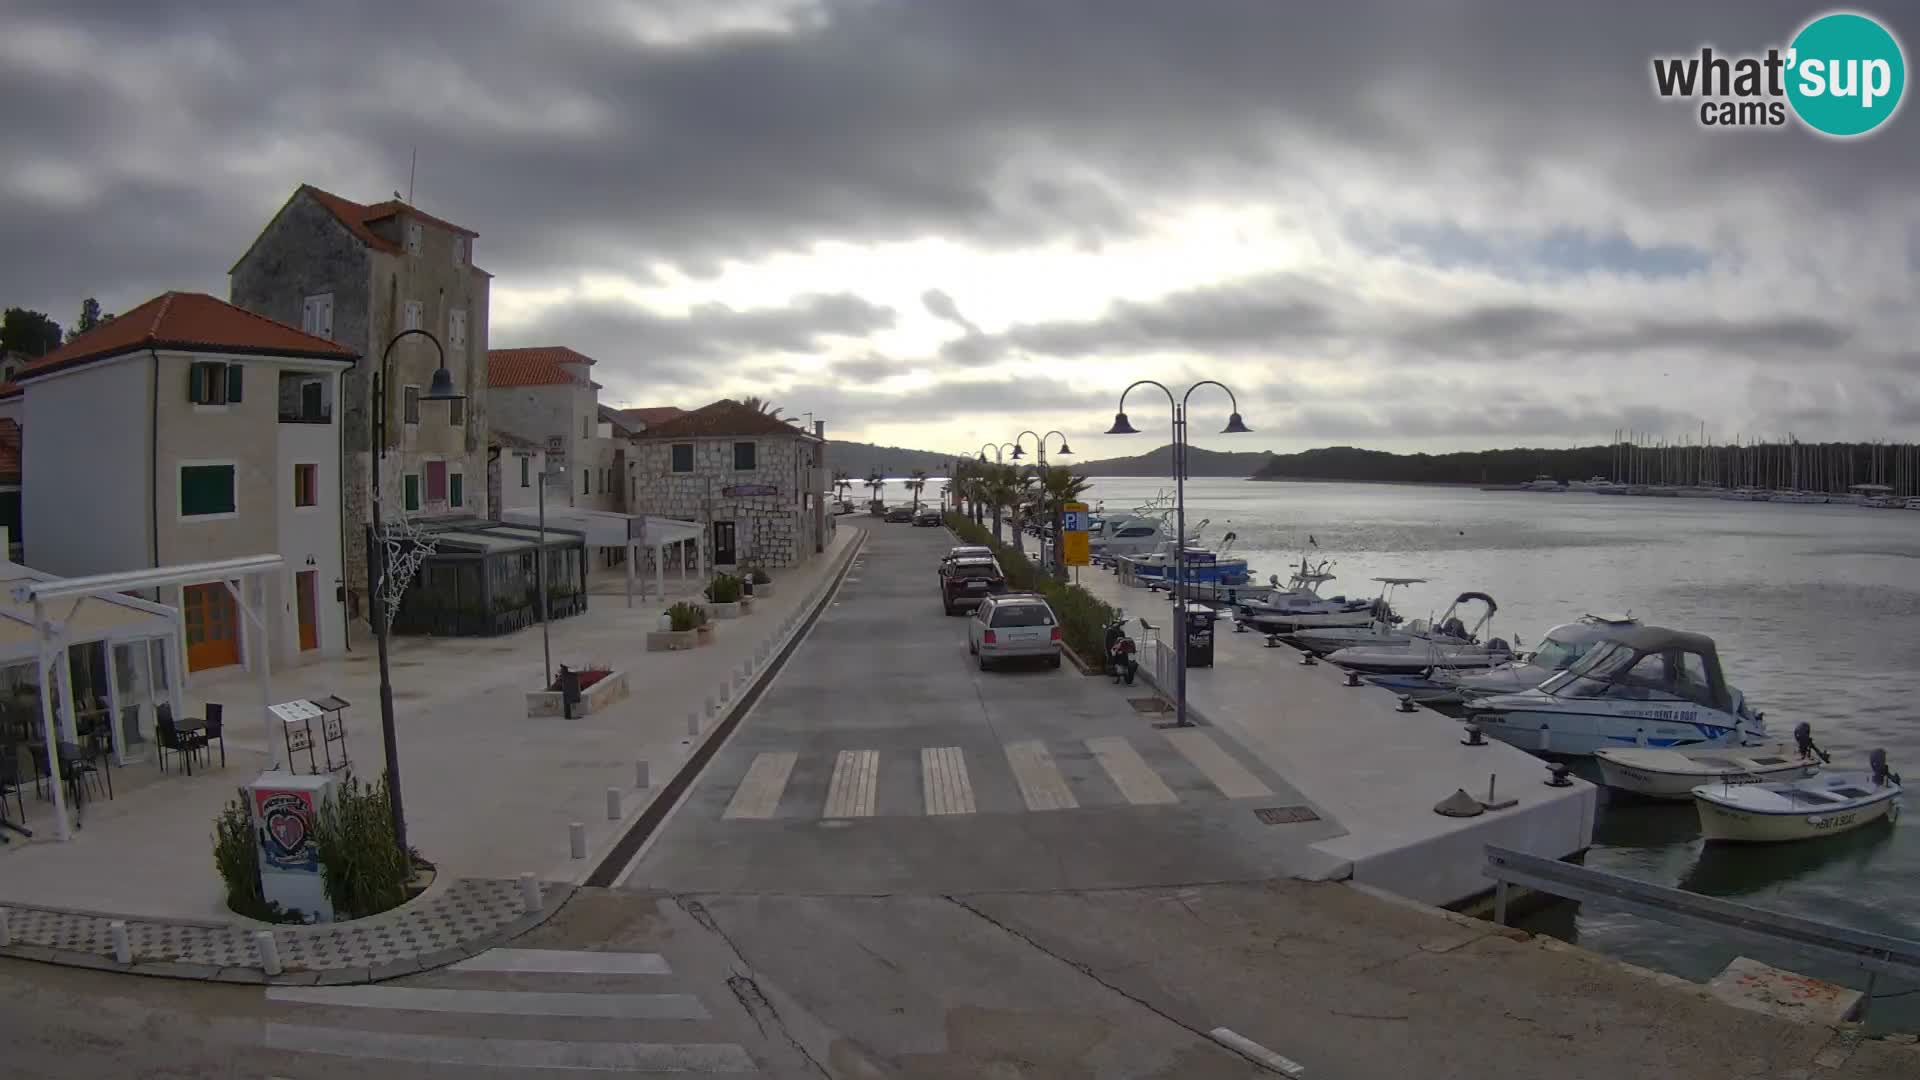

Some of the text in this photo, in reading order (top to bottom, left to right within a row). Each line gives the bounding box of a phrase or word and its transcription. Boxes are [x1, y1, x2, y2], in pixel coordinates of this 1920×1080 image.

[1065, 513, 1076, 529] P
[1654, 710, 1673, 719] RENT
[1680, 711, 1698, 721] BOAT
